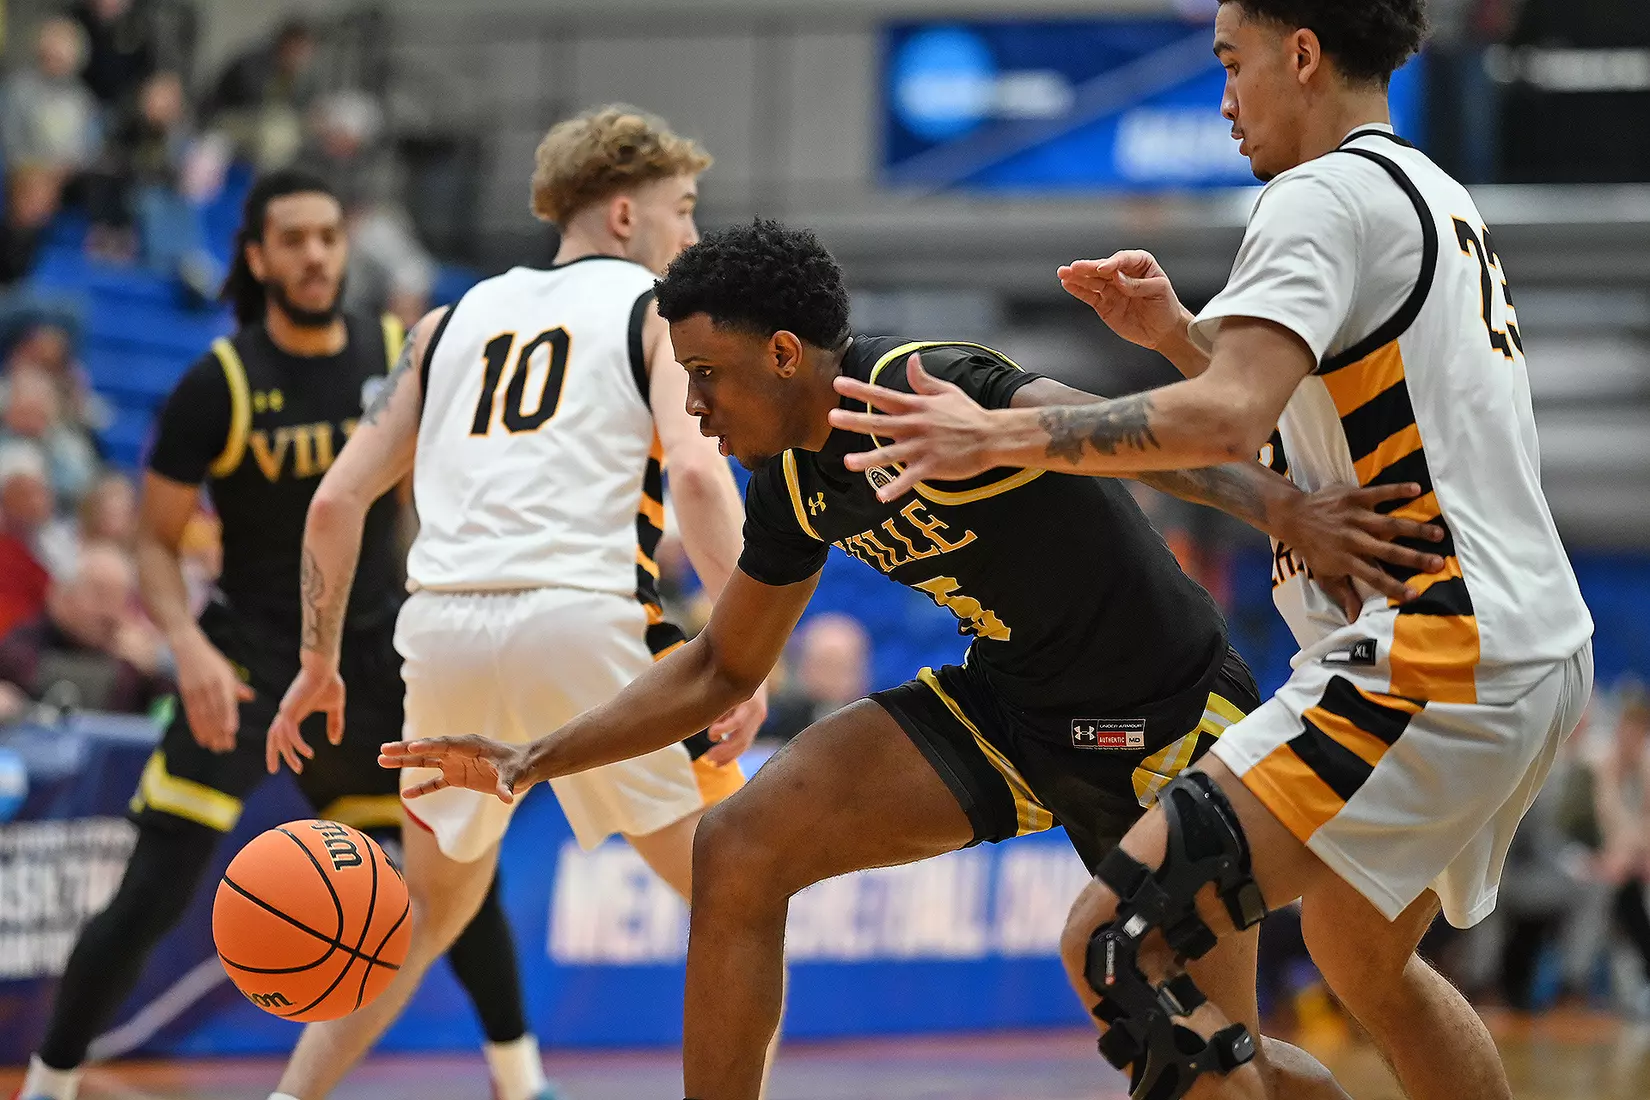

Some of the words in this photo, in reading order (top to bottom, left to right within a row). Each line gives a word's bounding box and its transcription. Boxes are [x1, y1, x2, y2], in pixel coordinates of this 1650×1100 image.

[469, 325, 572, 438] 10
[250, 417, 360, 483] VIL
[1354, 644, 1369, 659] XL
[1099, 736, 1125, 744] AUTHENTIC
